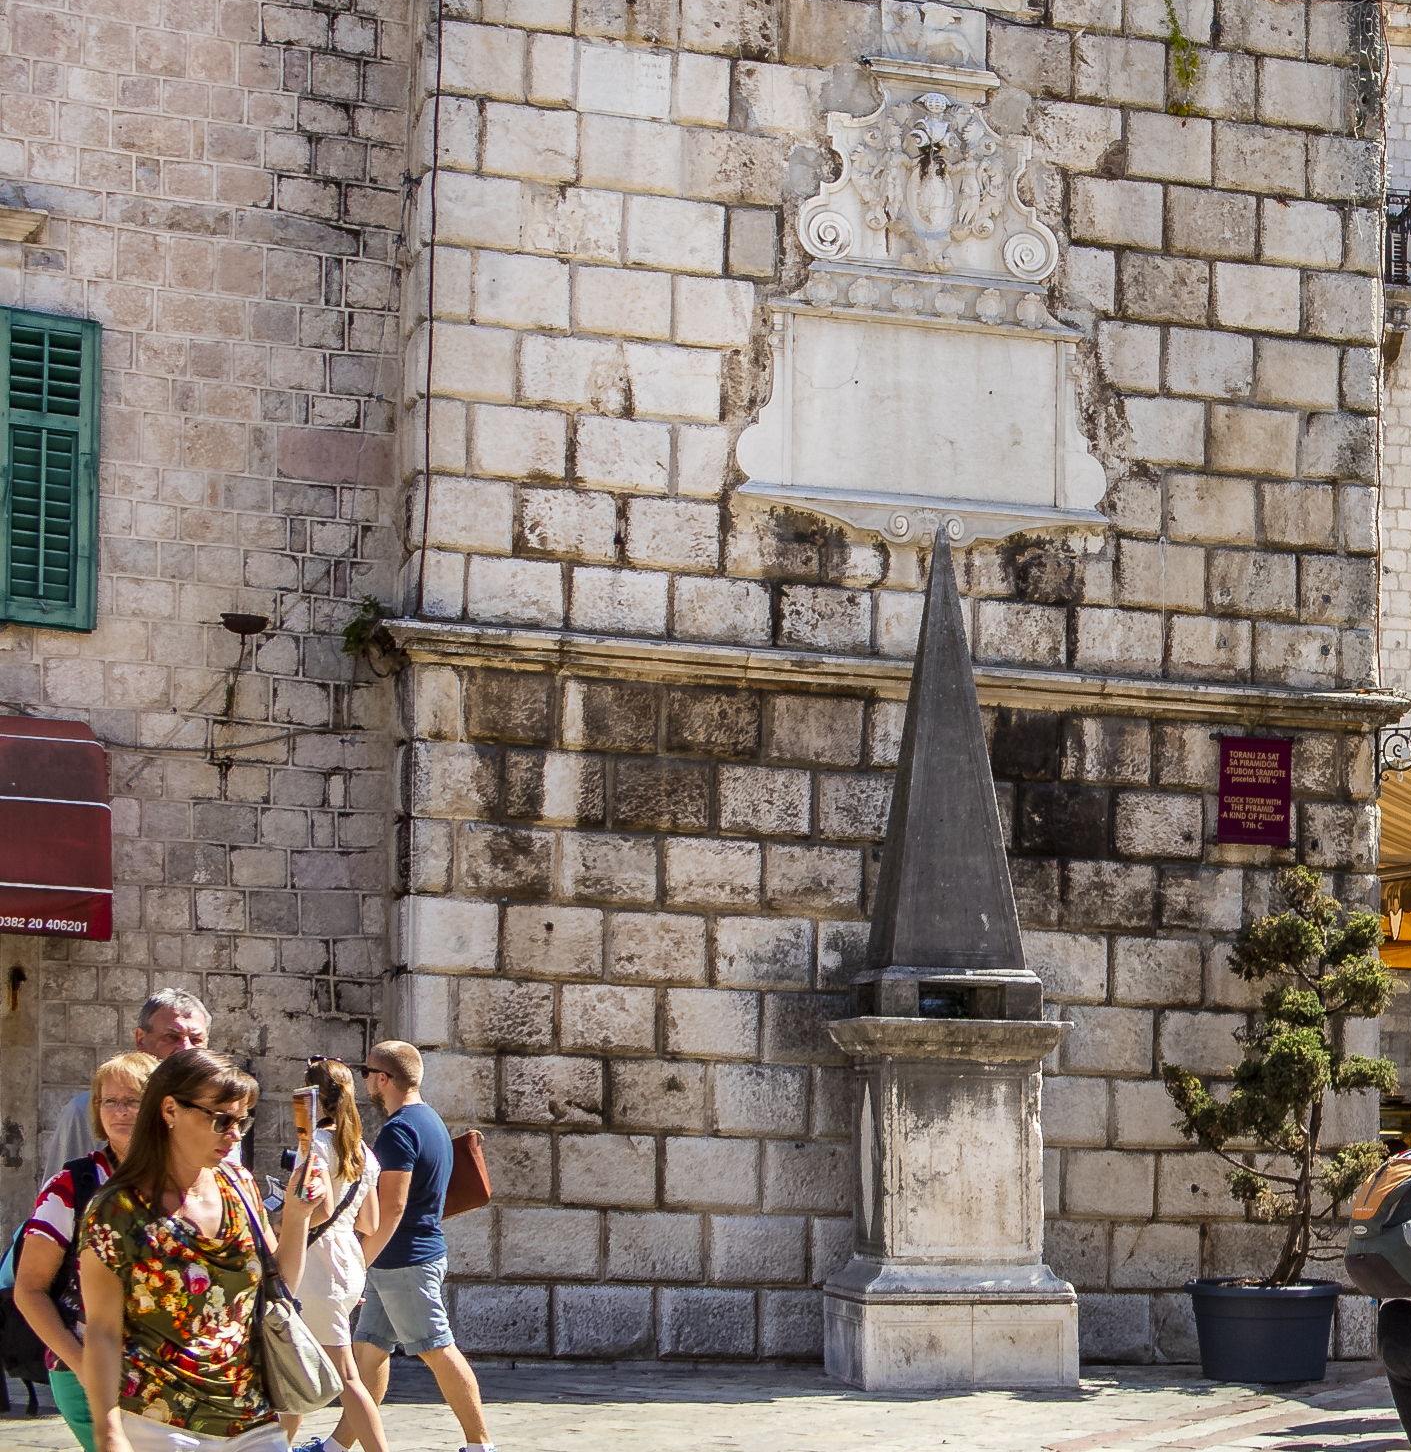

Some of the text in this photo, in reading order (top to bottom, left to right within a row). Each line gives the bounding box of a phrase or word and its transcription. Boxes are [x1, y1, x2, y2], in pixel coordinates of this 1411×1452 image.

[1230, 750, 1256, 759] TORANJ
[1240, 759, 1278, 768] PIRAMIDOM
[1256, 769, 1286, 777] SRAMOTE
[1246, 804, 1274, 812] PYRAMID
[1259, 813, 1284, 821] PILLORY
[28, 918, 43, 929] 20
[46, 919, 87, 932] 406201
